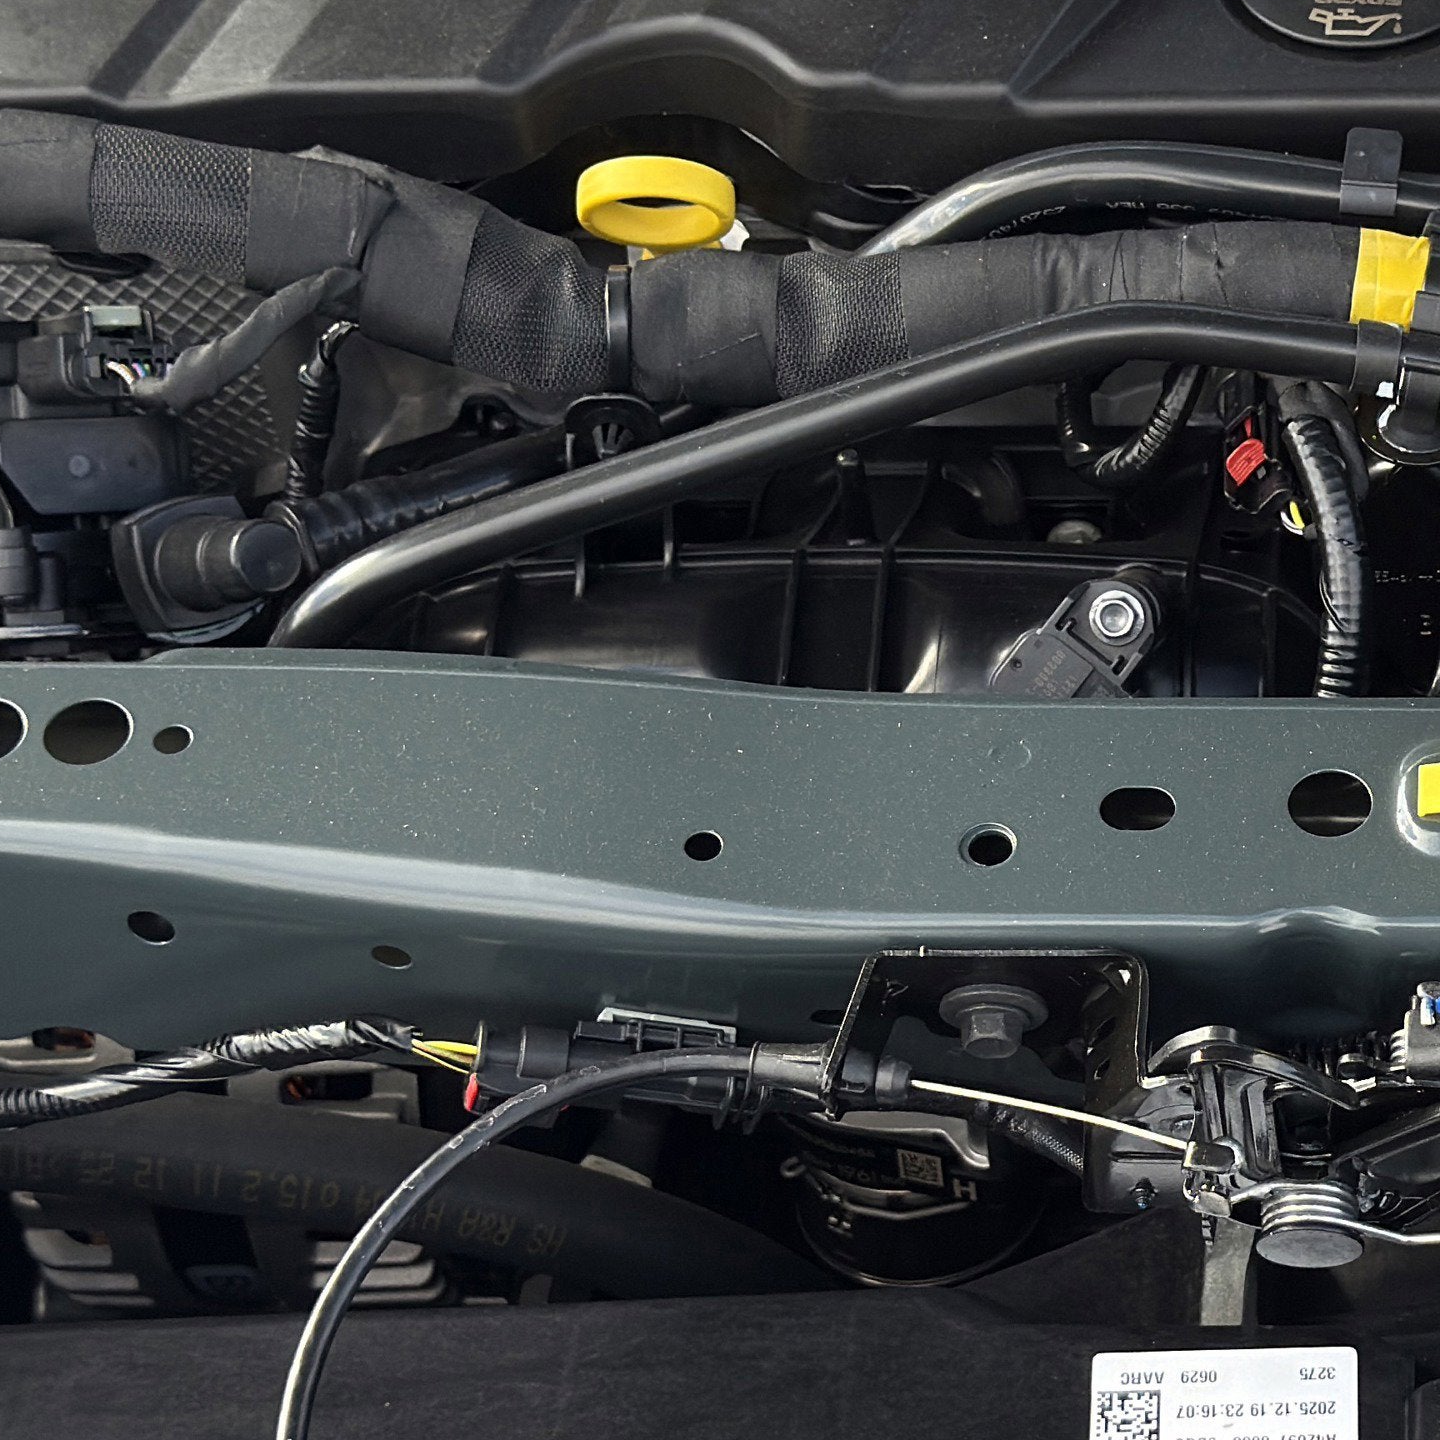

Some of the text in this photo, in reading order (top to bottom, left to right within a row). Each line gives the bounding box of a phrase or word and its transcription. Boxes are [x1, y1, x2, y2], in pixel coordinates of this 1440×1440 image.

[1180, 1369, 1218, 1384] 0629
[1299, 1366, 1337, 1381] 3275
[1175, 1400, 1337, 1419] 2025.12.19 23:16:07
